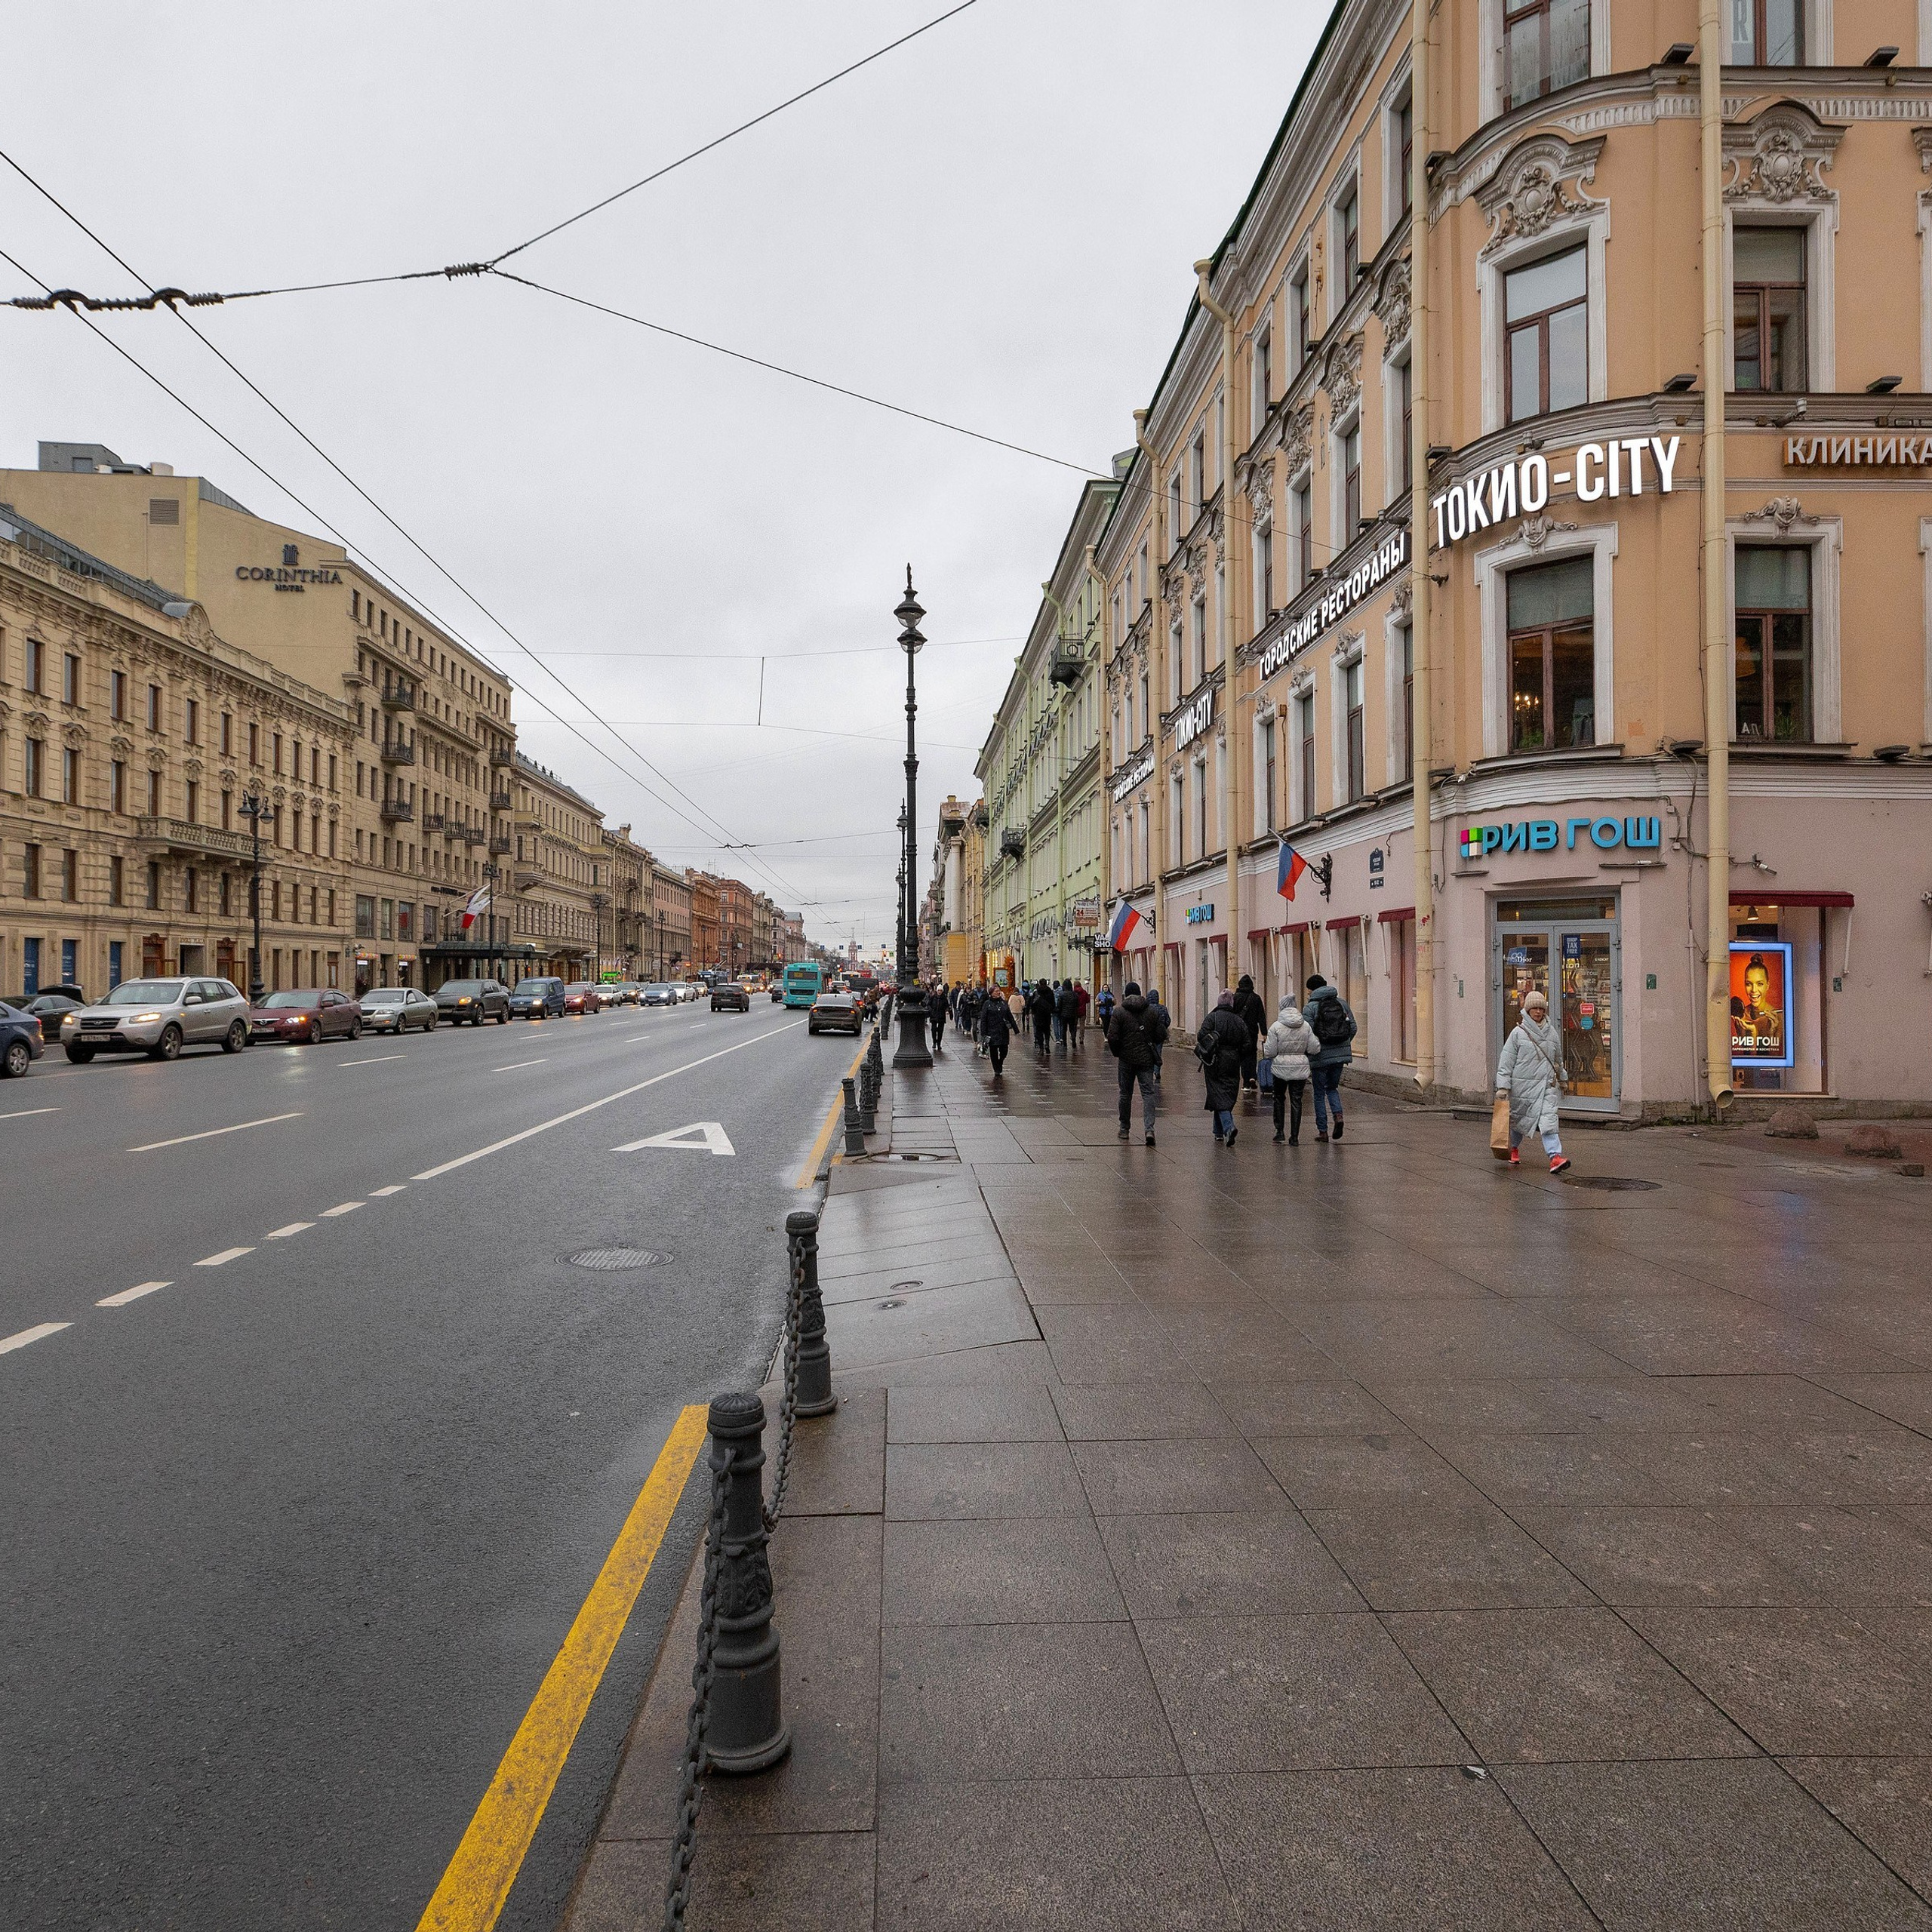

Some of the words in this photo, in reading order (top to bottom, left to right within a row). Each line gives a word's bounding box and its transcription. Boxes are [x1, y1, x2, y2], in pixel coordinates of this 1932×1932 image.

[1432, 435, 1681, 549] ТОКИО-CITY
[235, 565, 343, 584] CORINTHIA
[274, 583, 305, 592] HOTEL
[1259, 608, 1318, 681] ГОРОДСКИЕ
[1321, 531, 1406, 629] РЕСТОРАНЫ
[1482, 820, 1559, 855] РИВ
[1567, 817, 1660, 849] ГОШ
[1732, 1036, 1754, 1046] РИВ
[1756, 1036, 1780, 1046] ГОШ
